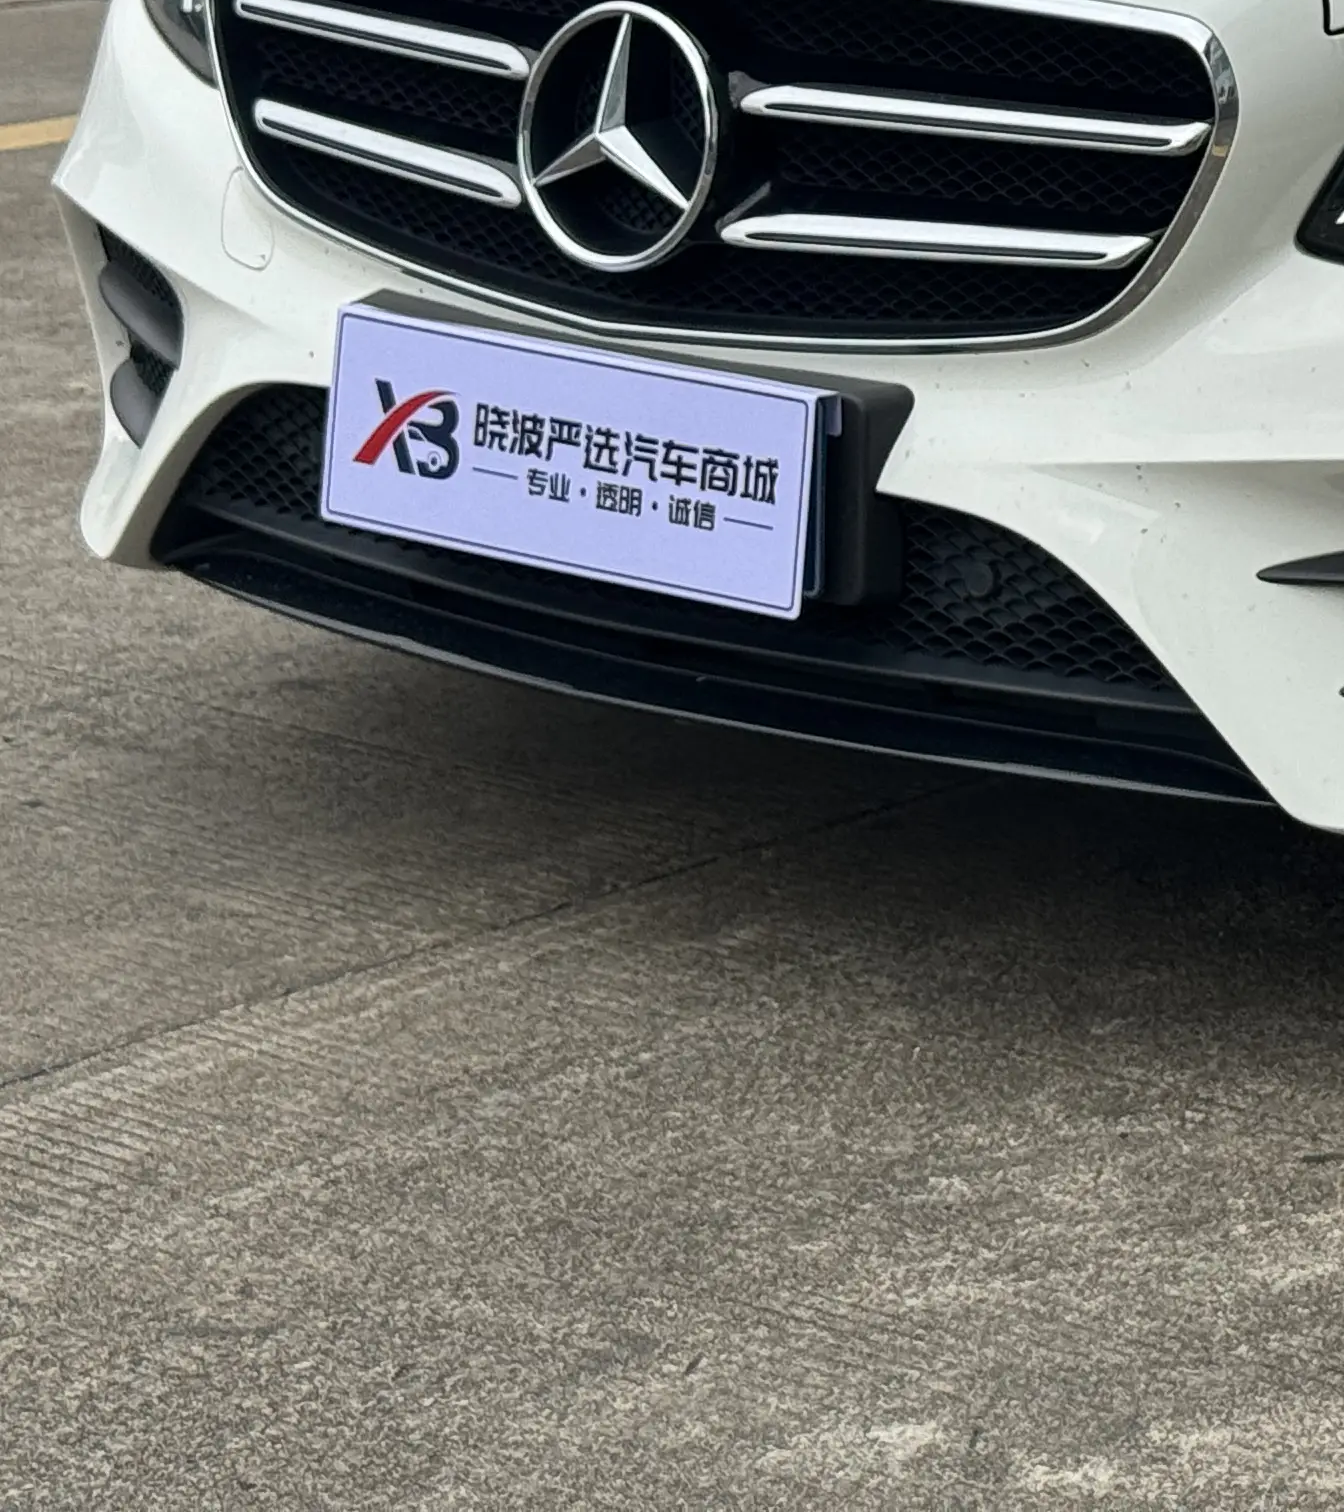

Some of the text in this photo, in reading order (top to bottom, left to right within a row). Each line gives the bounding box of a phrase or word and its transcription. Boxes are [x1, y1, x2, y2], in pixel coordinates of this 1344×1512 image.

[474, 402, 779, 505] 晓波严选汽车商城
